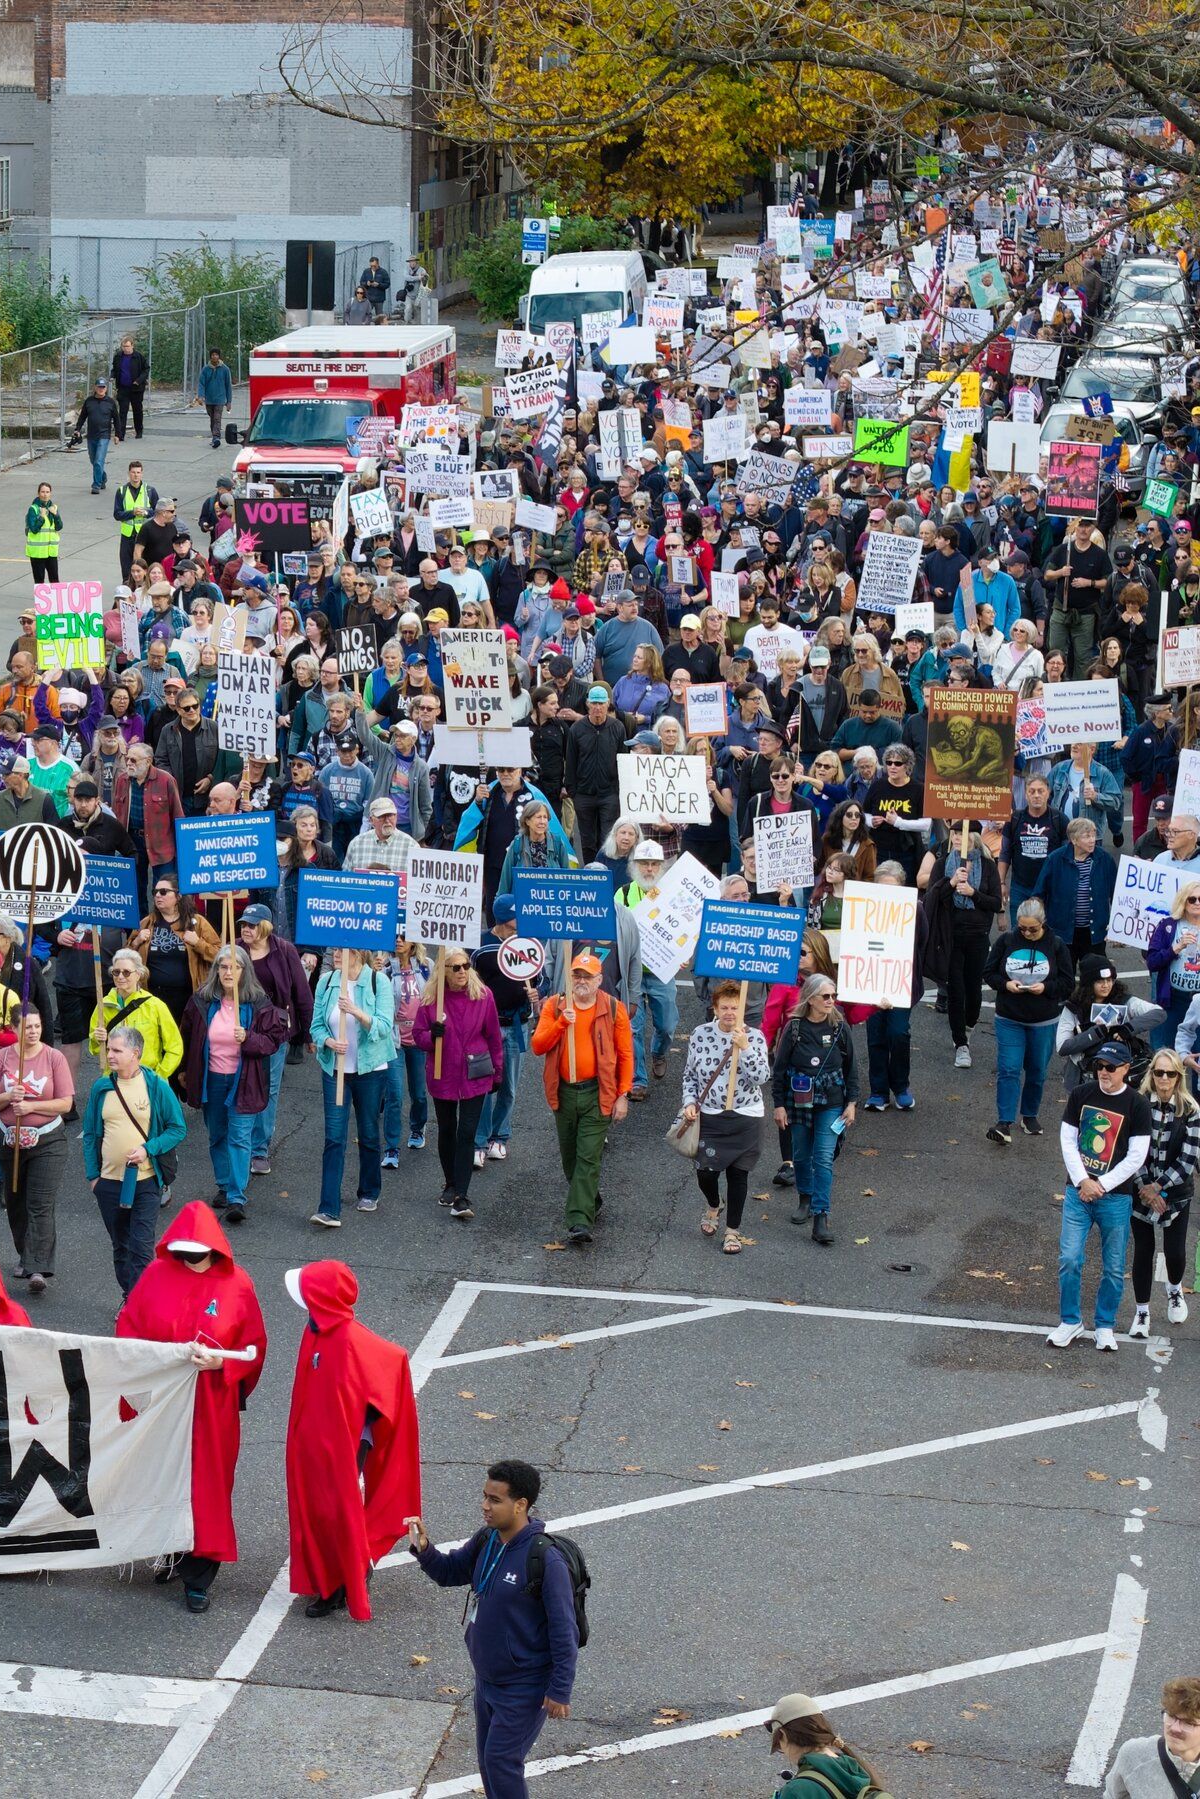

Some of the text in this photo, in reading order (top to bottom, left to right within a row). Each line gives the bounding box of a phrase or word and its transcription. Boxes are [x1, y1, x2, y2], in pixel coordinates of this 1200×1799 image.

[735, 246, 760, 256] NO HATE
[648, 300, 679, 308] IMPEACH
[648, 316, 678, 326] AGAIN
[951, 312, 979, 324] VOTE
[554, 328, 570, 336] ICE
[502, 336, 522, 344] VOTE
[286, 364, 368, 372] SEATTLE FIRE DEPT.
[510, 368, 552, 384] VOTING
[511, 379, 558, 396] WEAPON
[514, 390, 555, 410] TYRANN
[412, 406, 448, 416] KING OF
[412, 417, 450, 428] THE PEDO
[600, 414, 639, 428] VOTE
[602, 430, 640, 443] VOTE
[1076, 429, 1103, 442] ICE
[406, 454, 429, 465] VOTE
[604, 446, 639, 458] VOTE
[408, 463, 428, 474] VOTE
[750, 456, 793, 476] NO KINGS
[759, 472, 774, 484] NO
[351, 490, 385, 511] TAX
[243, 502, 308, 524] VOTE
[356, 509, 389, 530] RICH
[34, 581, 104, 614] STOP
[36, 612, 104, 640] BEING
[441, 631, 502, 646] AMERICA
[36, 636, 105, 670] EVIL!
[340, 646, 375, 673] KINGS
[219, 653, 271, 676] ILHAN
[222, 674, 270, 694] OMAR
[452, 673, 500, 688] WAKE
[238, 694, 252, 704] IS
[455, 696, 503, 711] FUCK
[691, 691, 718, 702] vote!
[934, 690, 1014, 704] UNCHECKED POWER
[218, 703, 274, 720] AMERICA
[934, 701, 1008, 713] IS COMING FOR US ALL
[222, 718, 268, 734] AT ITS
[466, 712, 491, 726] UP
[1049, 720, 1120, 734] Vote Now!
[225, 732, 267, 754] BEST
[637, 756, 690, 778] MAGA
[646, 779, 676, 792] IS A
[627, 792, 698, 814] CANCER
[181, 822, 210, 830] IMAGINE
[218, 818, 244, 826] BETTER
[245, 816, 270, 824] WORLD
[755, 814, 810, 830] TO DO LIST
[766, 829, 787, 839] VOTE
[194, 834, 258, 851] IMMIGRANTS
[199, 852, 257, 867] ARE VALUED
[190, 868, 267, 886] AND RESPECTED
[411, 859, 479, 883] DEMOCRACY
[106, 878, 120, 888] TO
[700, 874, 715, 890] NO
[1125, 864, 1166, 894] BLUE
[420, 883, 468, 898] IS NOT A
[530, 888, 597, 902] RULE OF LAW
[94, 893, 134, 905] DISSENT
[306, 898, 388, 915] FREEDOM TO BE
[71, 905, 126, 920] DIFFERENCE
[413, 900, 475, 922] SPECTATOR
[522, 904, 609, 920] APPLIES EQUALLY
[844, 896, 915, 938] TRUMP
[310, 915, 382, 932] WHO YOU ARE
[549, 921, 584, 933] TO ALL
[664, 914, 680, 928] NO
[420, 920, 466, 942] SPORT
[652, 922, 673, 943] BEER
[705, 921, 798, 942] LEADERSHIP BASED
[503, 946, 538, 968] WAR
[707, 939, 792, 960] ON FACTS, TRUTH,
[714, 956, 780, 974] AND SCIENCE
